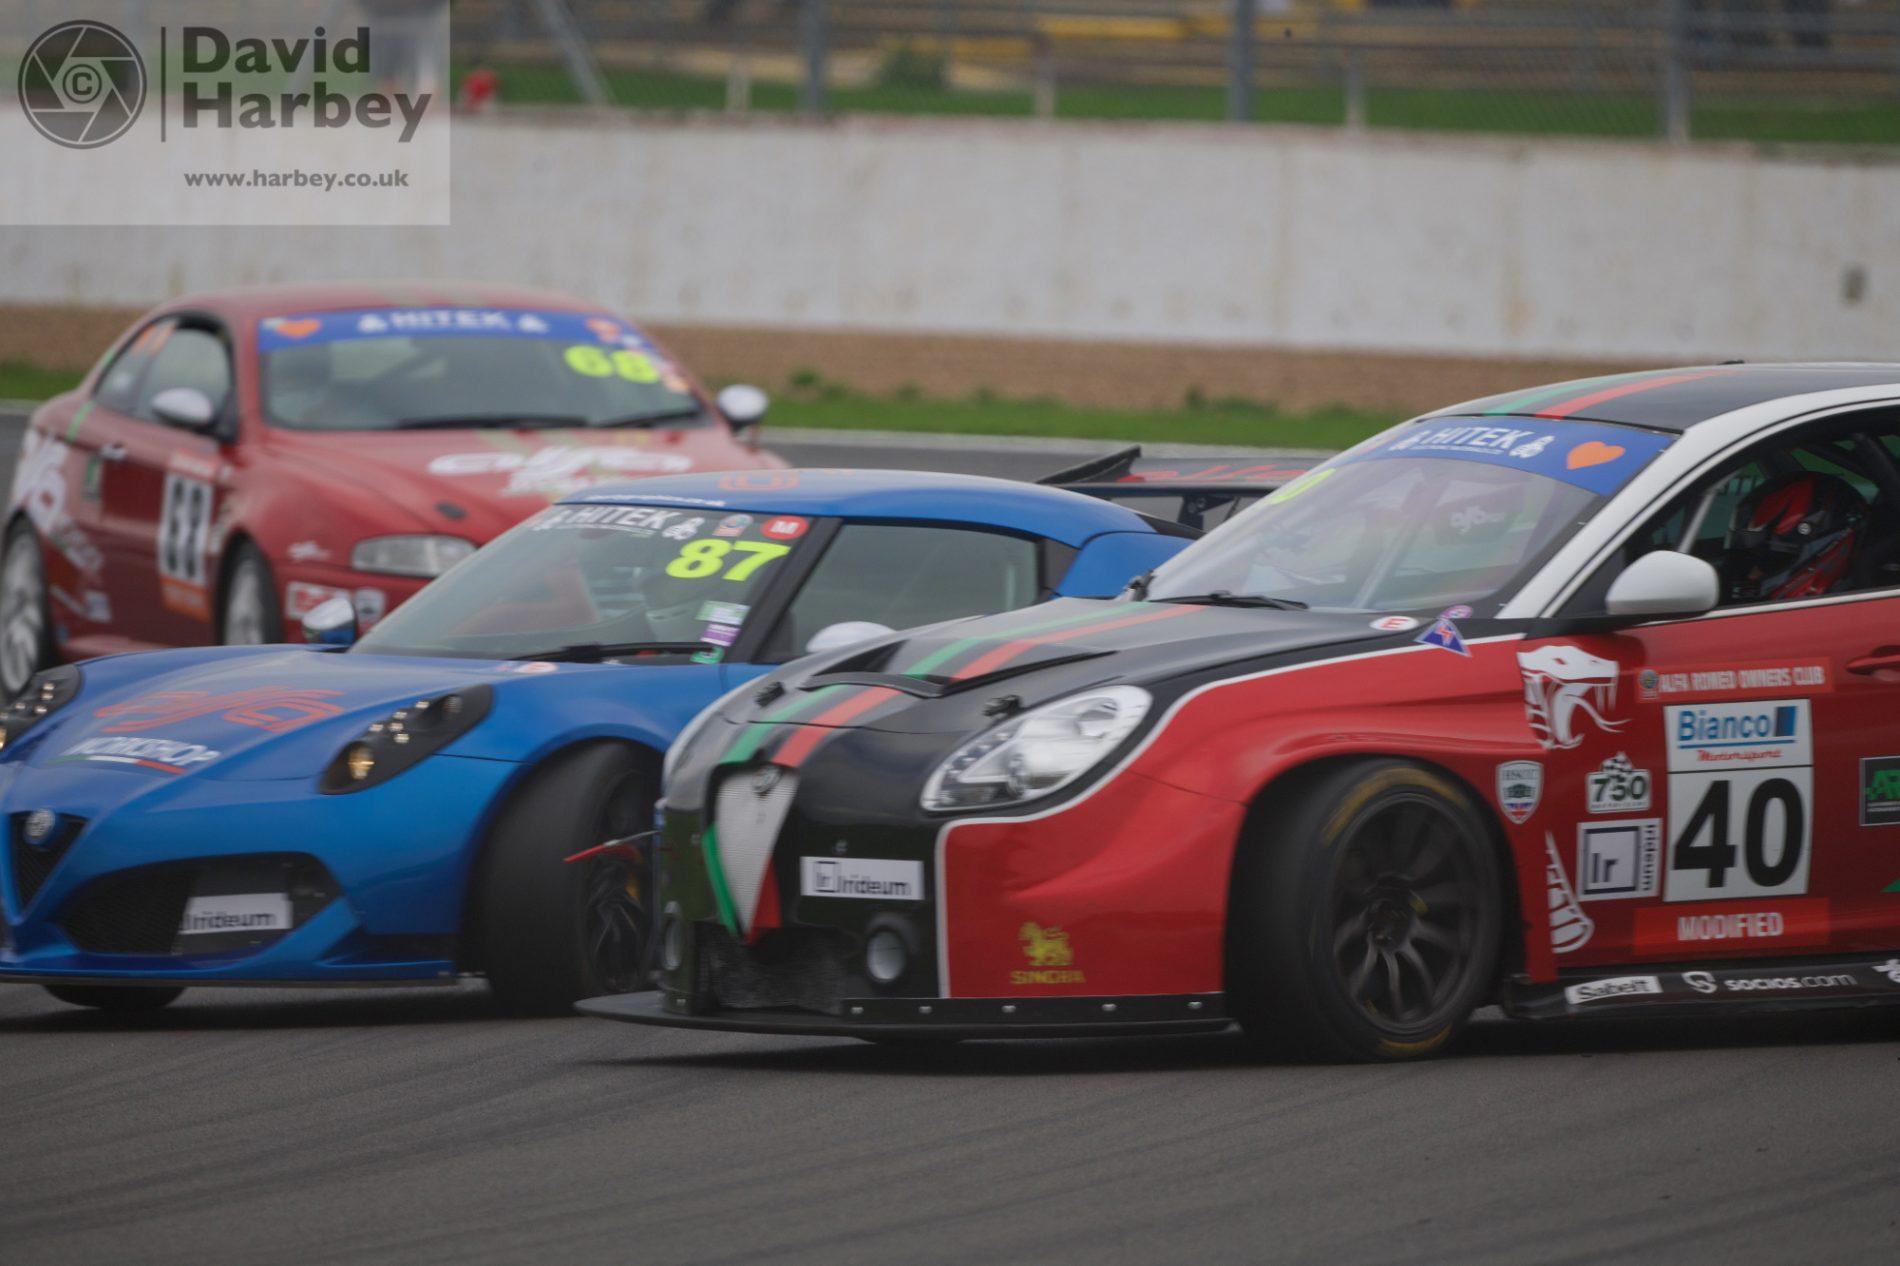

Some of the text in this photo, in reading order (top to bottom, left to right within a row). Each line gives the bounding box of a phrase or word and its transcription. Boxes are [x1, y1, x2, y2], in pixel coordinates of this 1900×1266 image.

[1425, 427, 1535, 449] HITEK
[570, 506, 682, 530] HITEK
[665, 538, 792, 581] 87
[1659, 673, 1691, 693] ALFA
[1739, 667, 1792, 688] OWNERS
[1793, 666, 1825, 686] CLUB
[1677, 709, 1772, 742] Bianco
[1592, 776, 1648, 802] 750
[1673, 778, 1806, 889] 40
[1677, 912, 1784, 941] MODIFIED
[1577, 979, 1648, 999] Sabelt
[1723, 974, 1858, 991] socios.com
